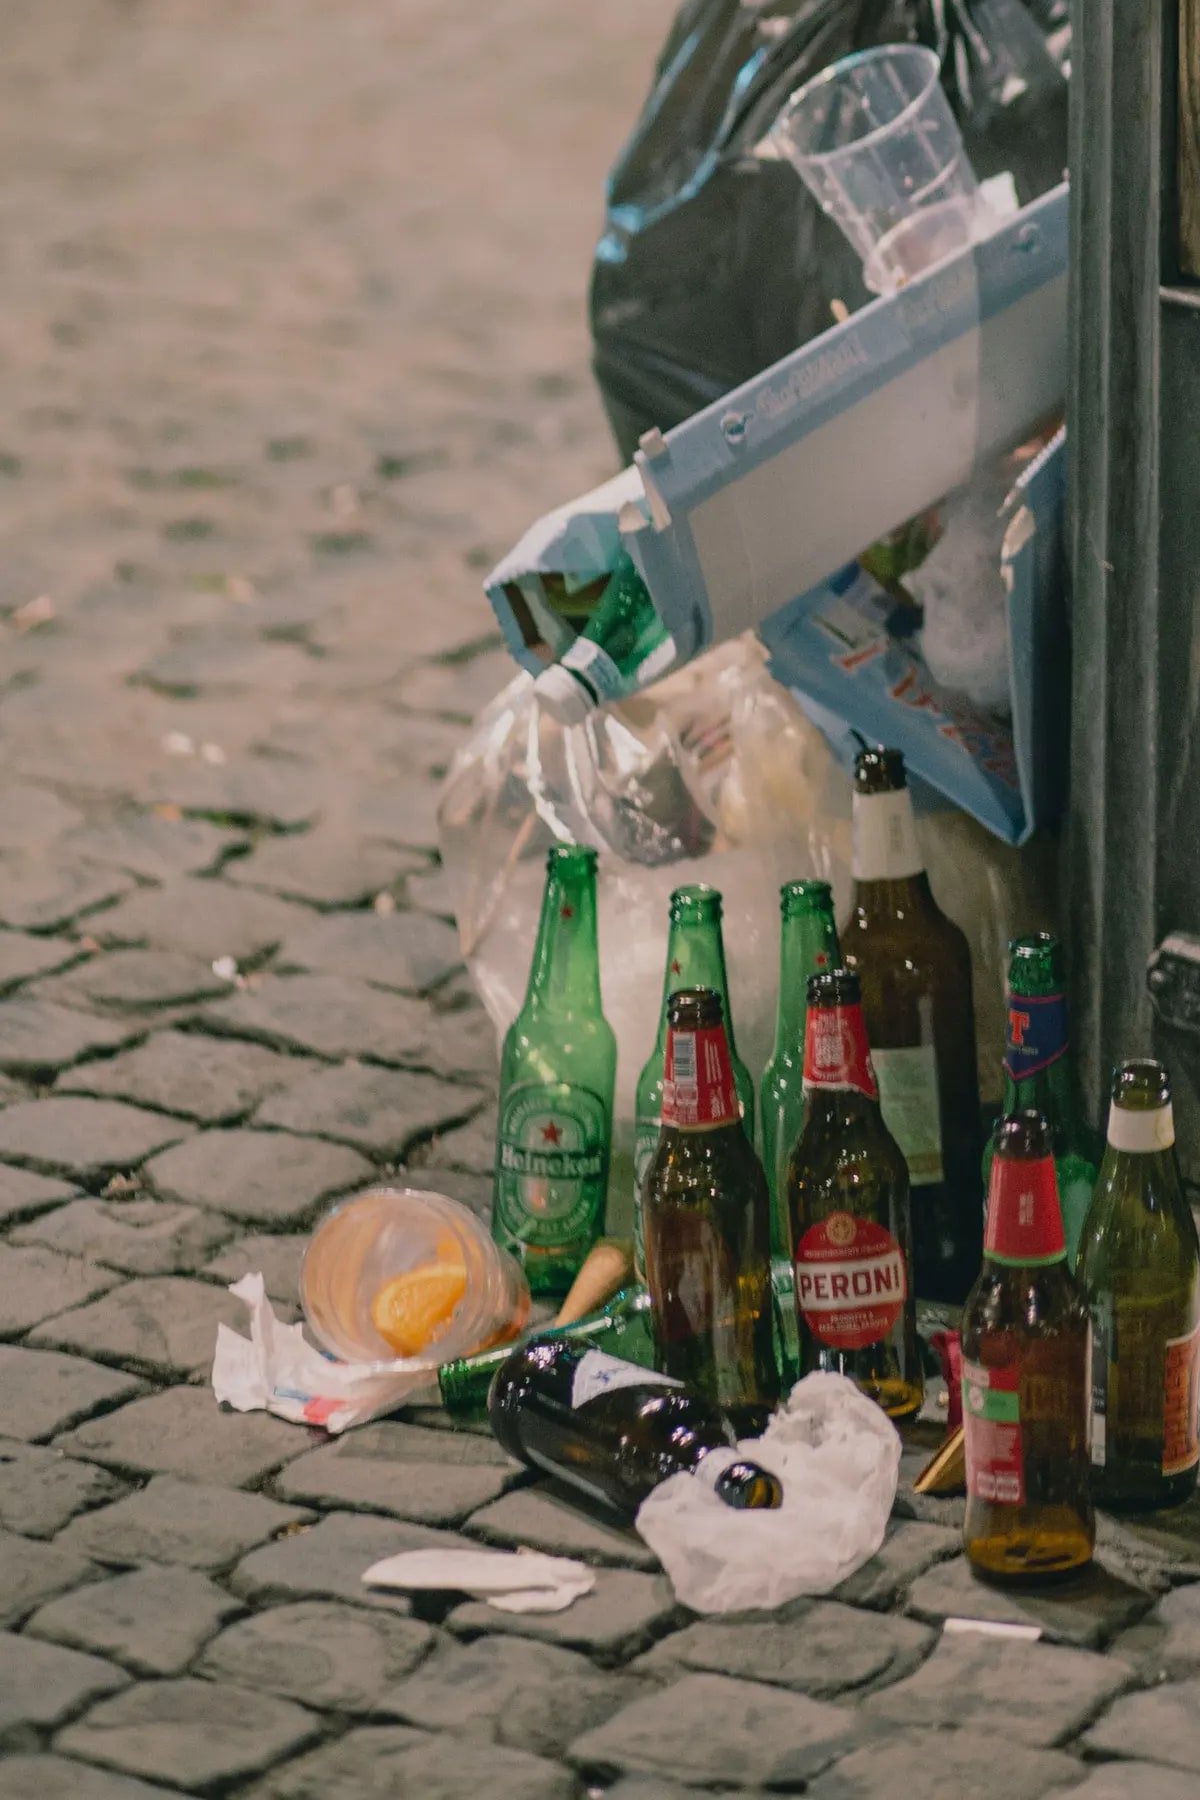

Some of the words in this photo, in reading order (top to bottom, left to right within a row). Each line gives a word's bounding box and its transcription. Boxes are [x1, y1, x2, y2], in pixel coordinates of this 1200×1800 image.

[1008, 1007, 1030, 1045] T
[501, 1144, 601, 1175] Heineken
[800, 1263, 900, 1300] PERONI
